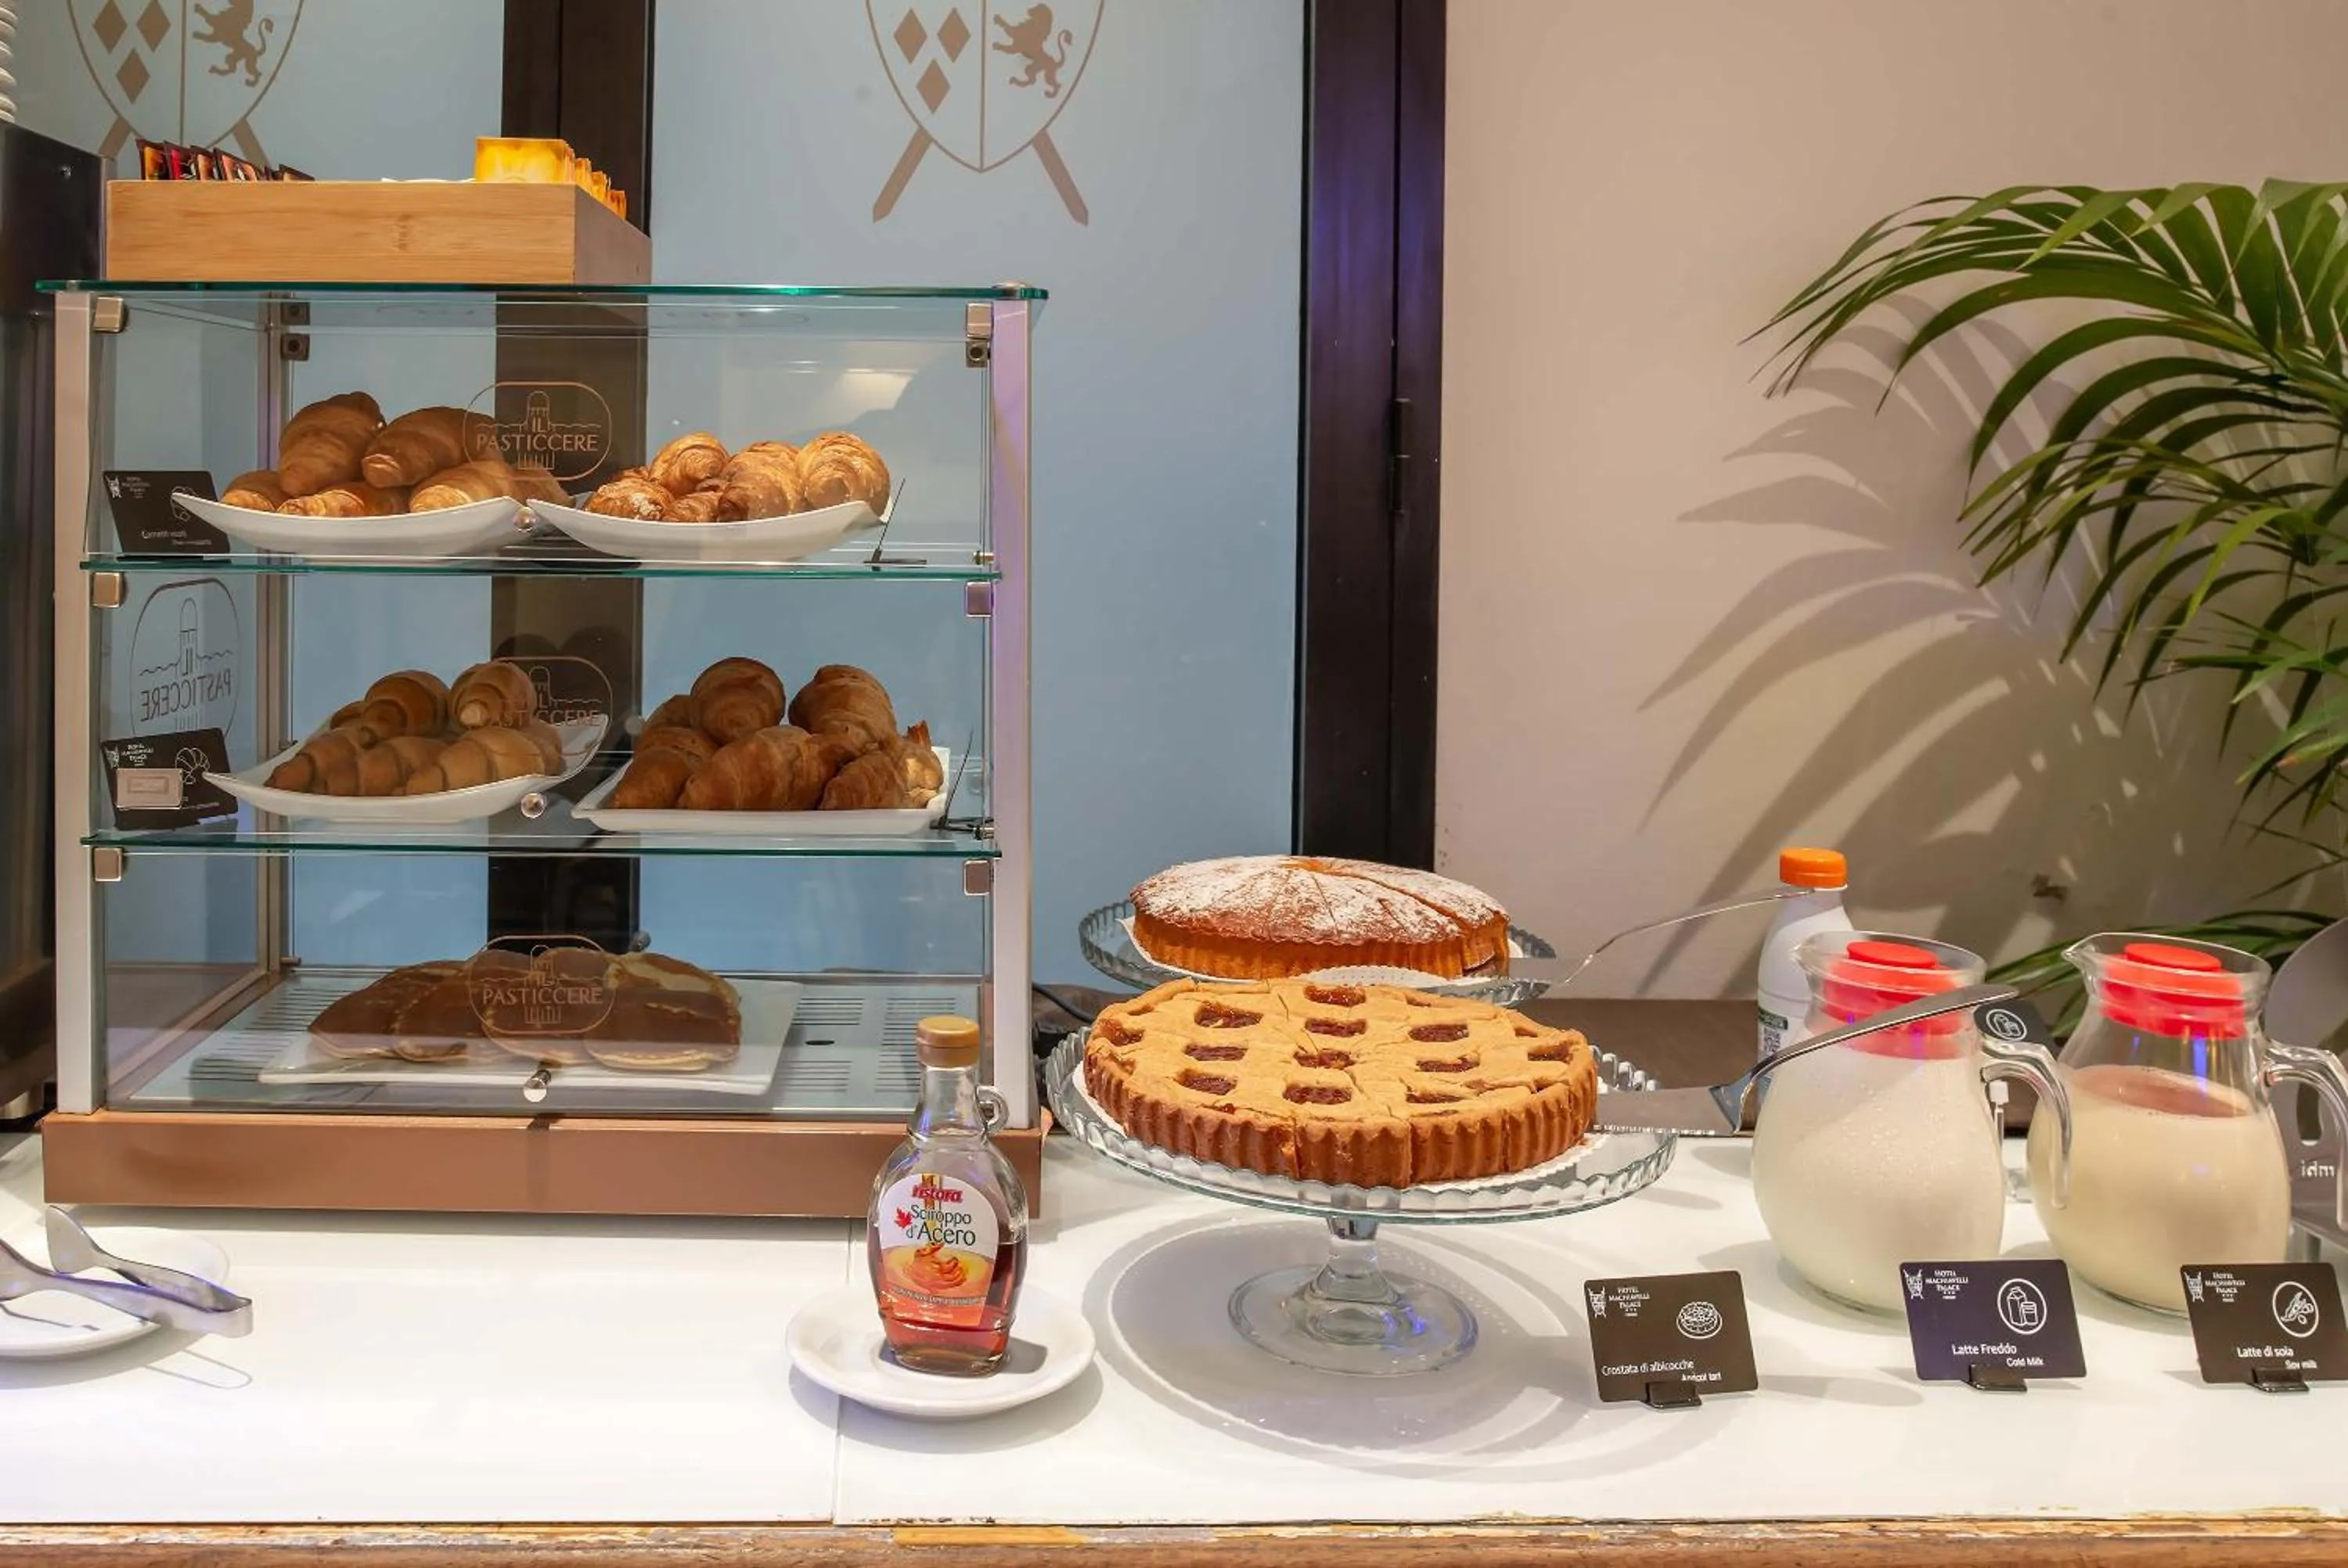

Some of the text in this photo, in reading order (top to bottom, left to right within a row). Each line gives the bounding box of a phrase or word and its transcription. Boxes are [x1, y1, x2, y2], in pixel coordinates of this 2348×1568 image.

[531, 417, 546, 433] IL
[476, 433, 600, 451] PASTICCERE
[482, 987, 603, 1005] PASTICCERE
[910, 1204, 972, 1228] Sciroppo
[906, 1221, 976, 1246] d'Acero
[1952, 1343, 2017, 1355] Latte Freddo
[2236, 1347, 2263, 1358] Latte
[2263, 1345, 2274, 1357] di
[1602, 1364, 1639, 1376] Crostata
[1650, 1359, 1694, 1372] albicocche
[2006, 1358, 2026, 1367] Cold
